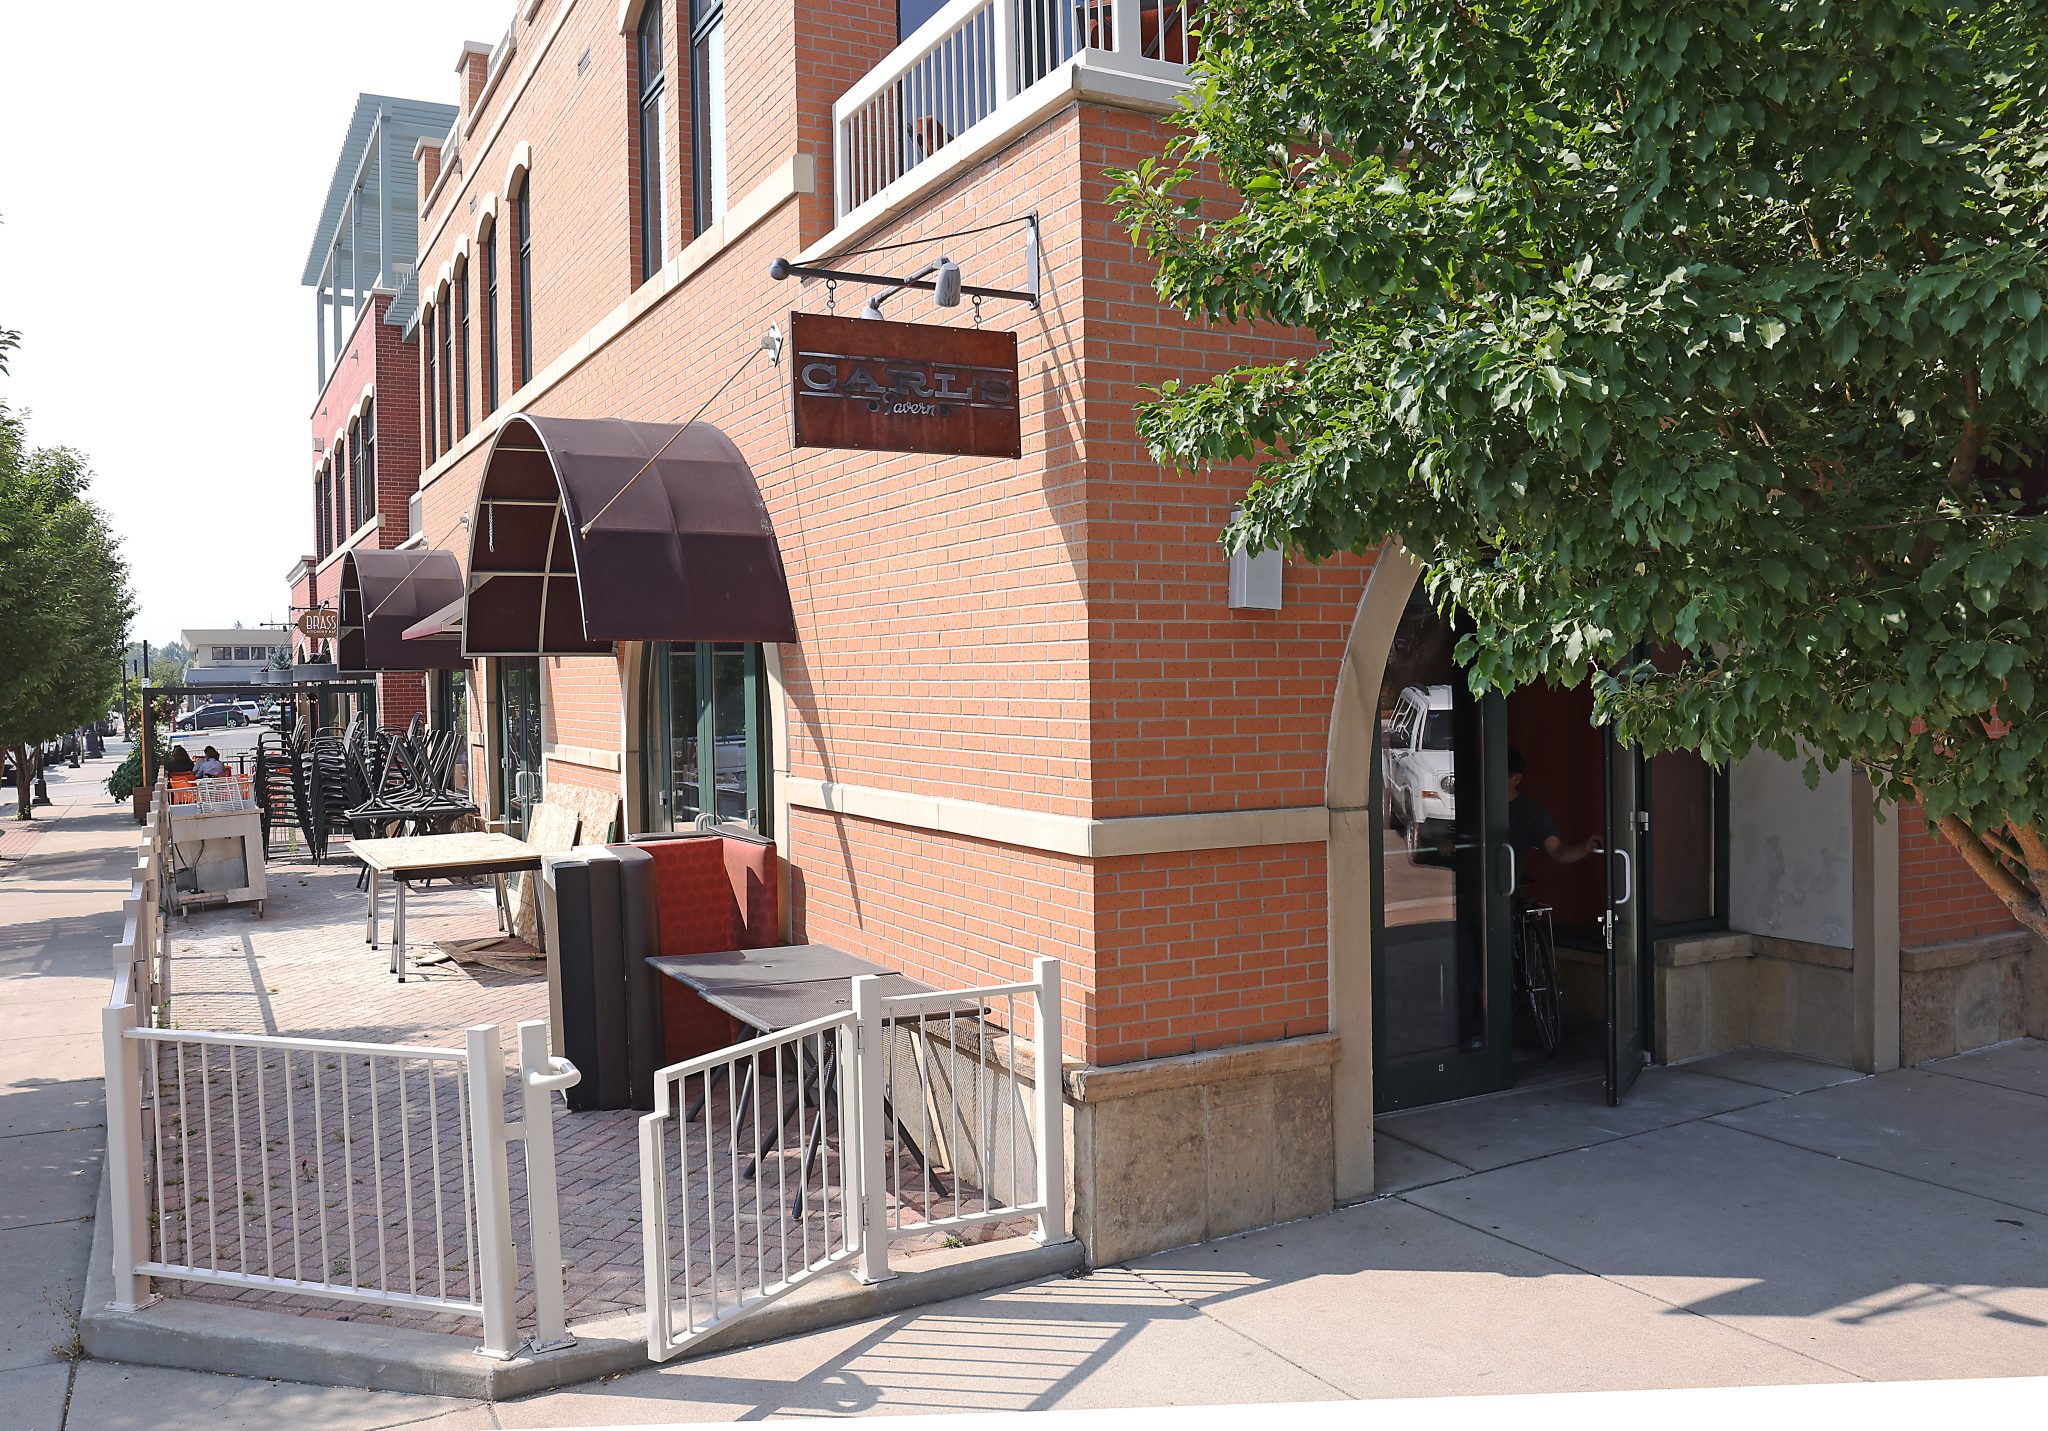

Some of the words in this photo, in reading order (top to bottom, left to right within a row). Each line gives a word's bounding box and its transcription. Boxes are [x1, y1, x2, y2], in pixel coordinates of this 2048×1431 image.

[801, 362, 1012, 403] CARL'S
[882, 391, 936, 416] Tavern
[306, 615, 337, 630] BRASS
